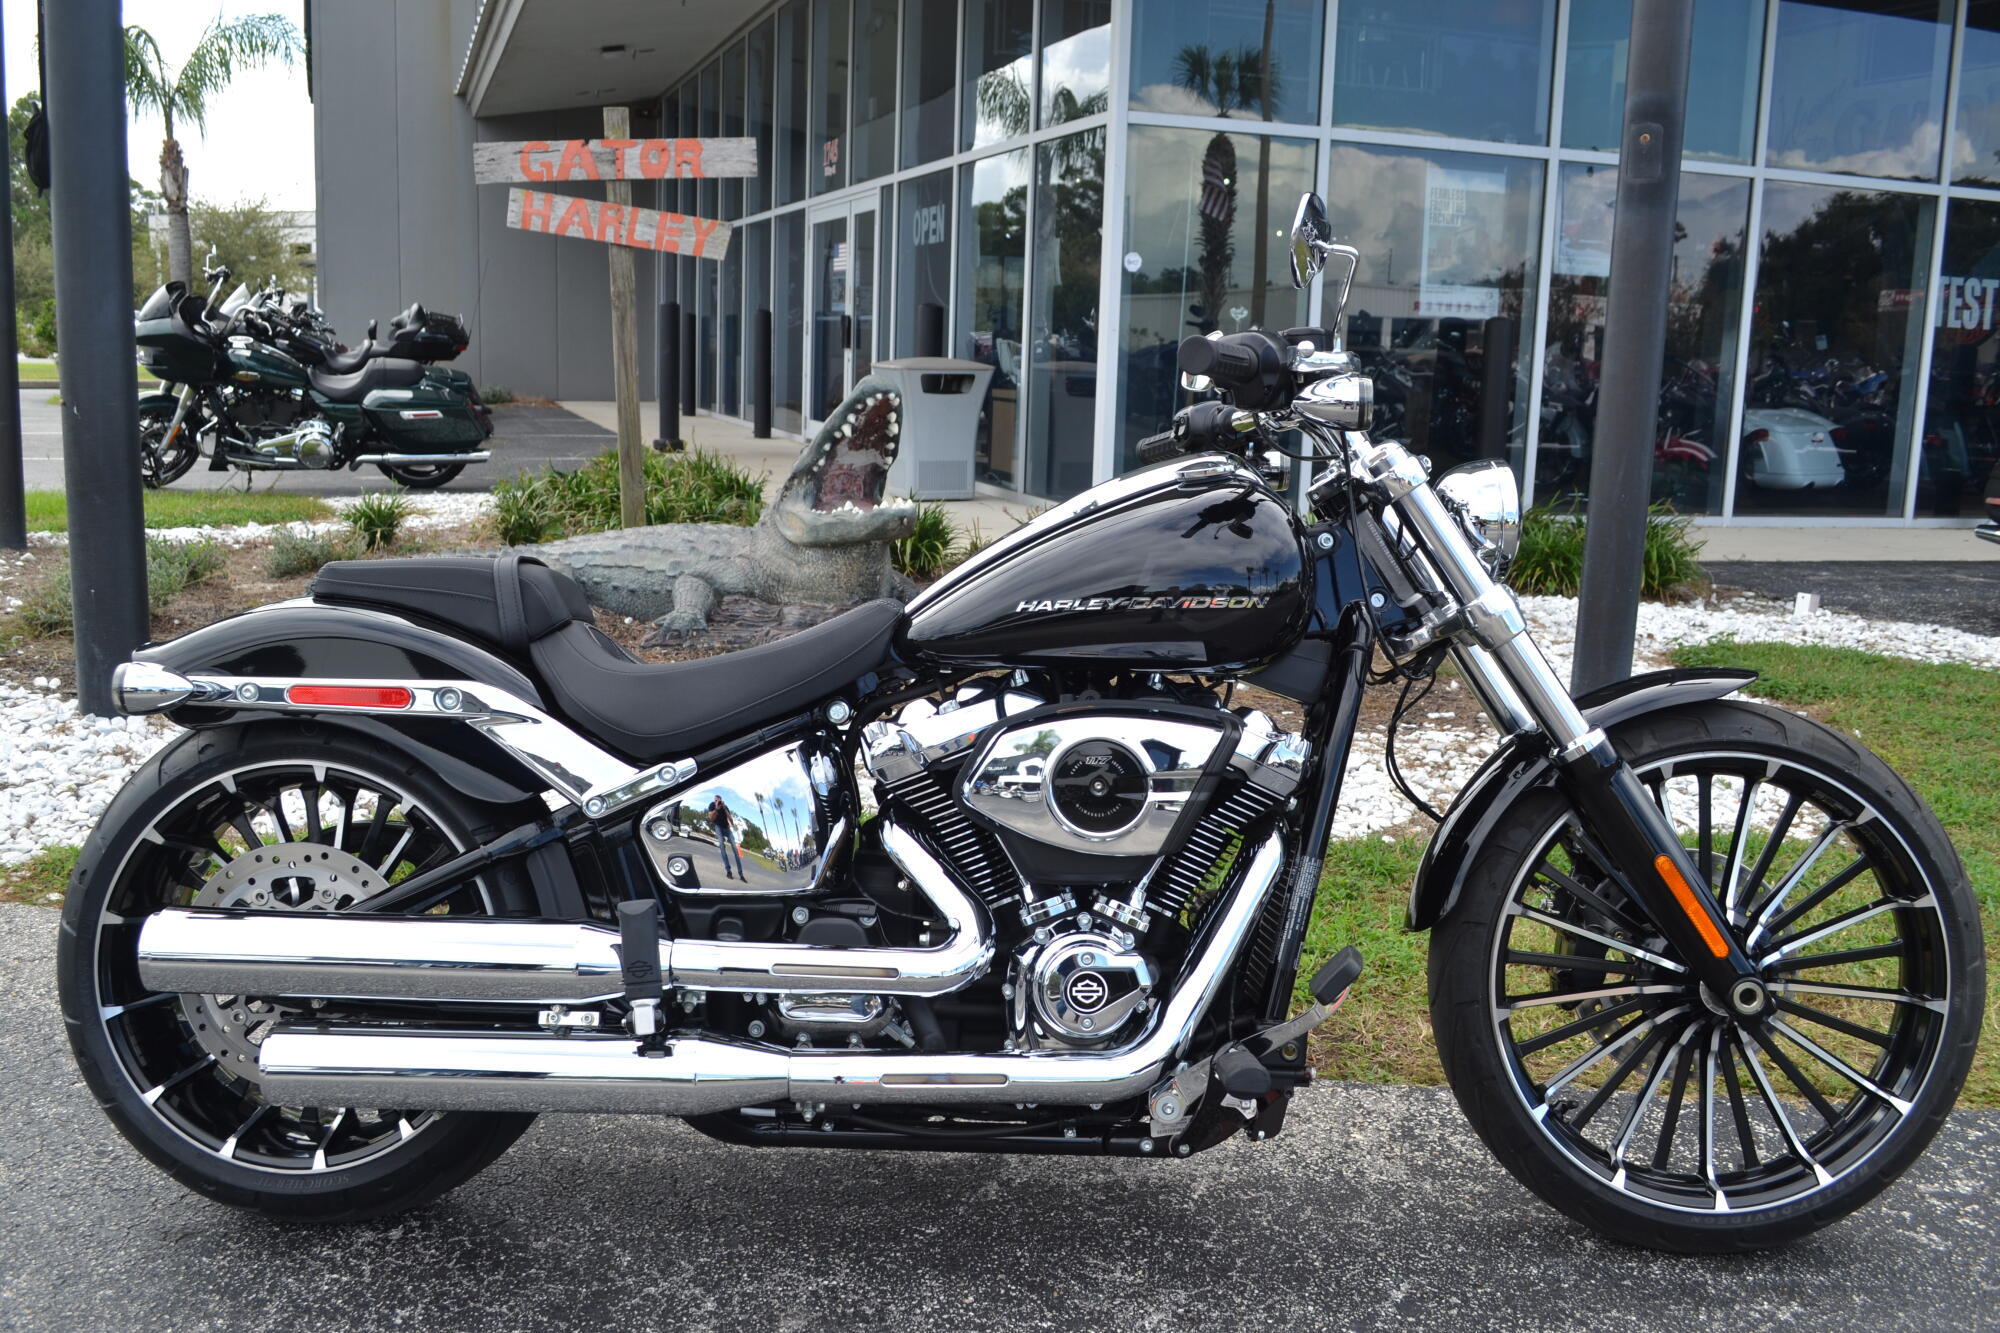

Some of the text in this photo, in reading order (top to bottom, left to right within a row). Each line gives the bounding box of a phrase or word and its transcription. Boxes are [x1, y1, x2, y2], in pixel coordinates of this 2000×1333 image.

[519, 138, 705, 182] GATOR
[521, 190, 718, 257] HARLEY
[913, 204, 945, 246] OPEN
[1934, 276, 2000, 331] TEST
[1085, 755, 1112, 765] 117
